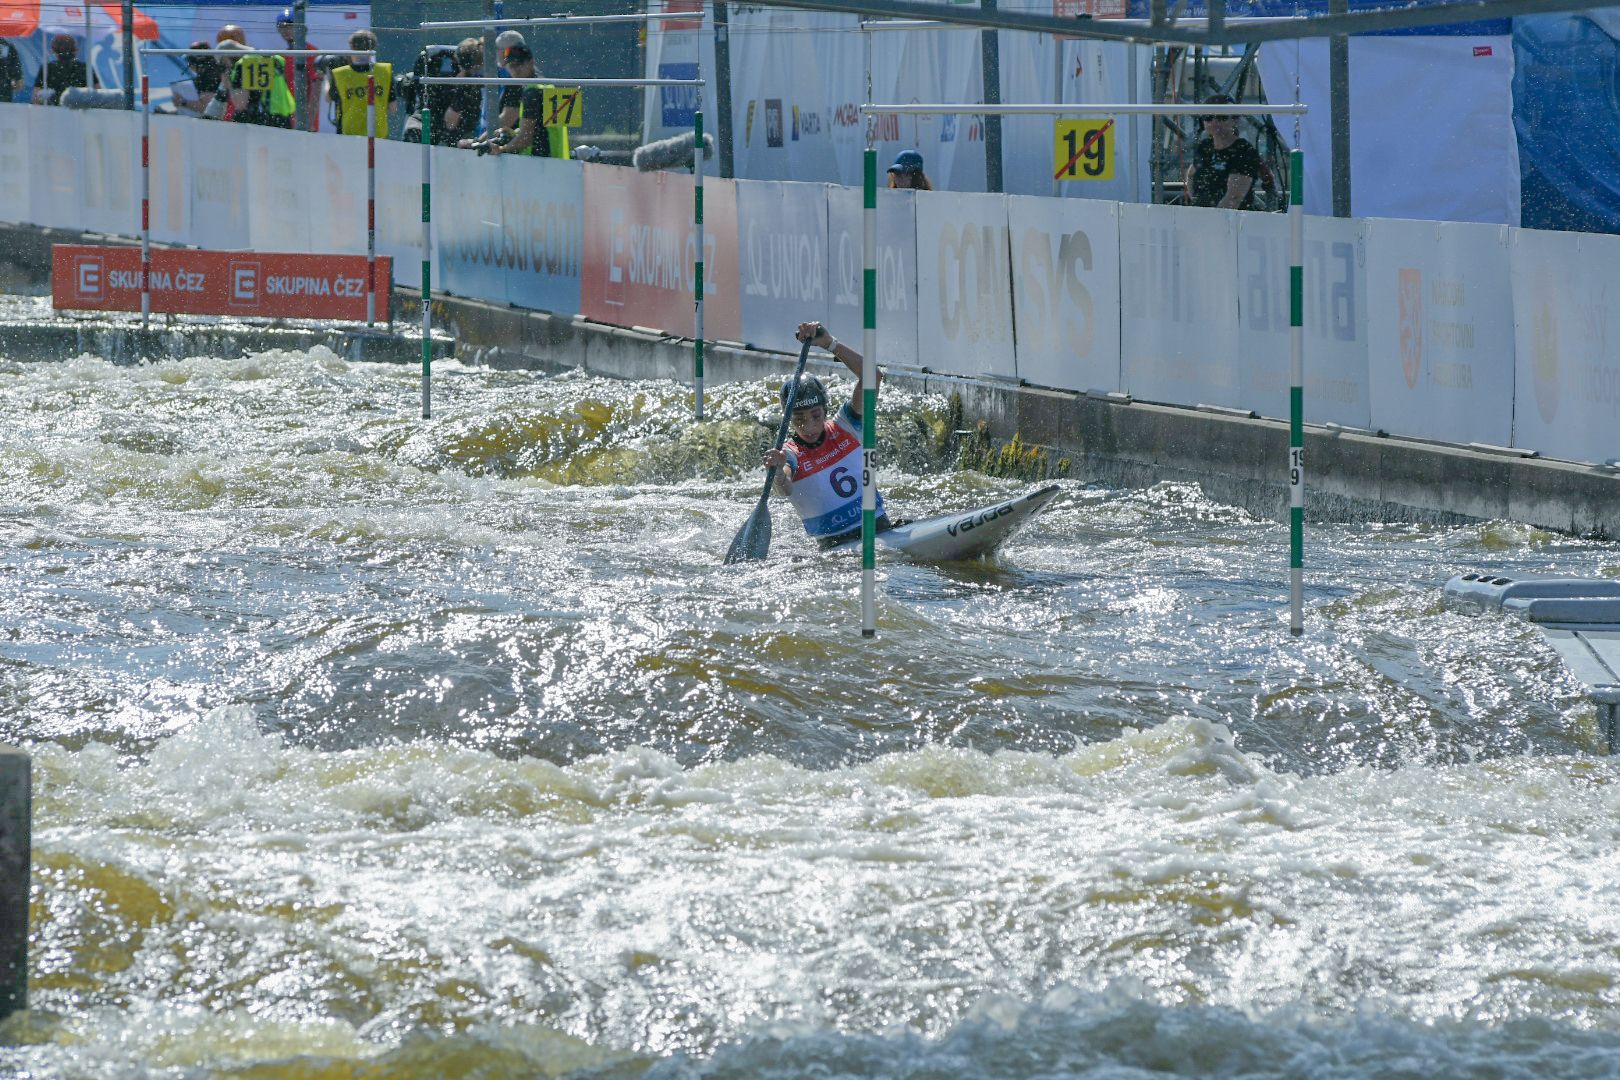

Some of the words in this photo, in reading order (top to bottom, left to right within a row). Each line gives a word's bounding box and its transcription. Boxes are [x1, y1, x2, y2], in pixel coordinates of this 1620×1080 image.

[247, 63, 270, 88] 15
[346, 86, 384, 99] FOO
[549, 94, 576, 124] 17
[1063, 129, 1105, 176] 19
[629, 223, 682, 290] SKUPINA
[686, 214, 717, 295] ČZ
[769, 233, 824, 301] UNIQA
[175, 266, 205, 291] ČEZ
[266, 275, 330, 296] SKUPINA
[334, 273, 364, 297] ČEZ
[424, 301, 430, 311] 7
[863, 451, 877, 468] 19
[830, 467, 858, 498] 6
[862, 469, 870, 486] 9
[1291, 469, 1299, 485] 9
